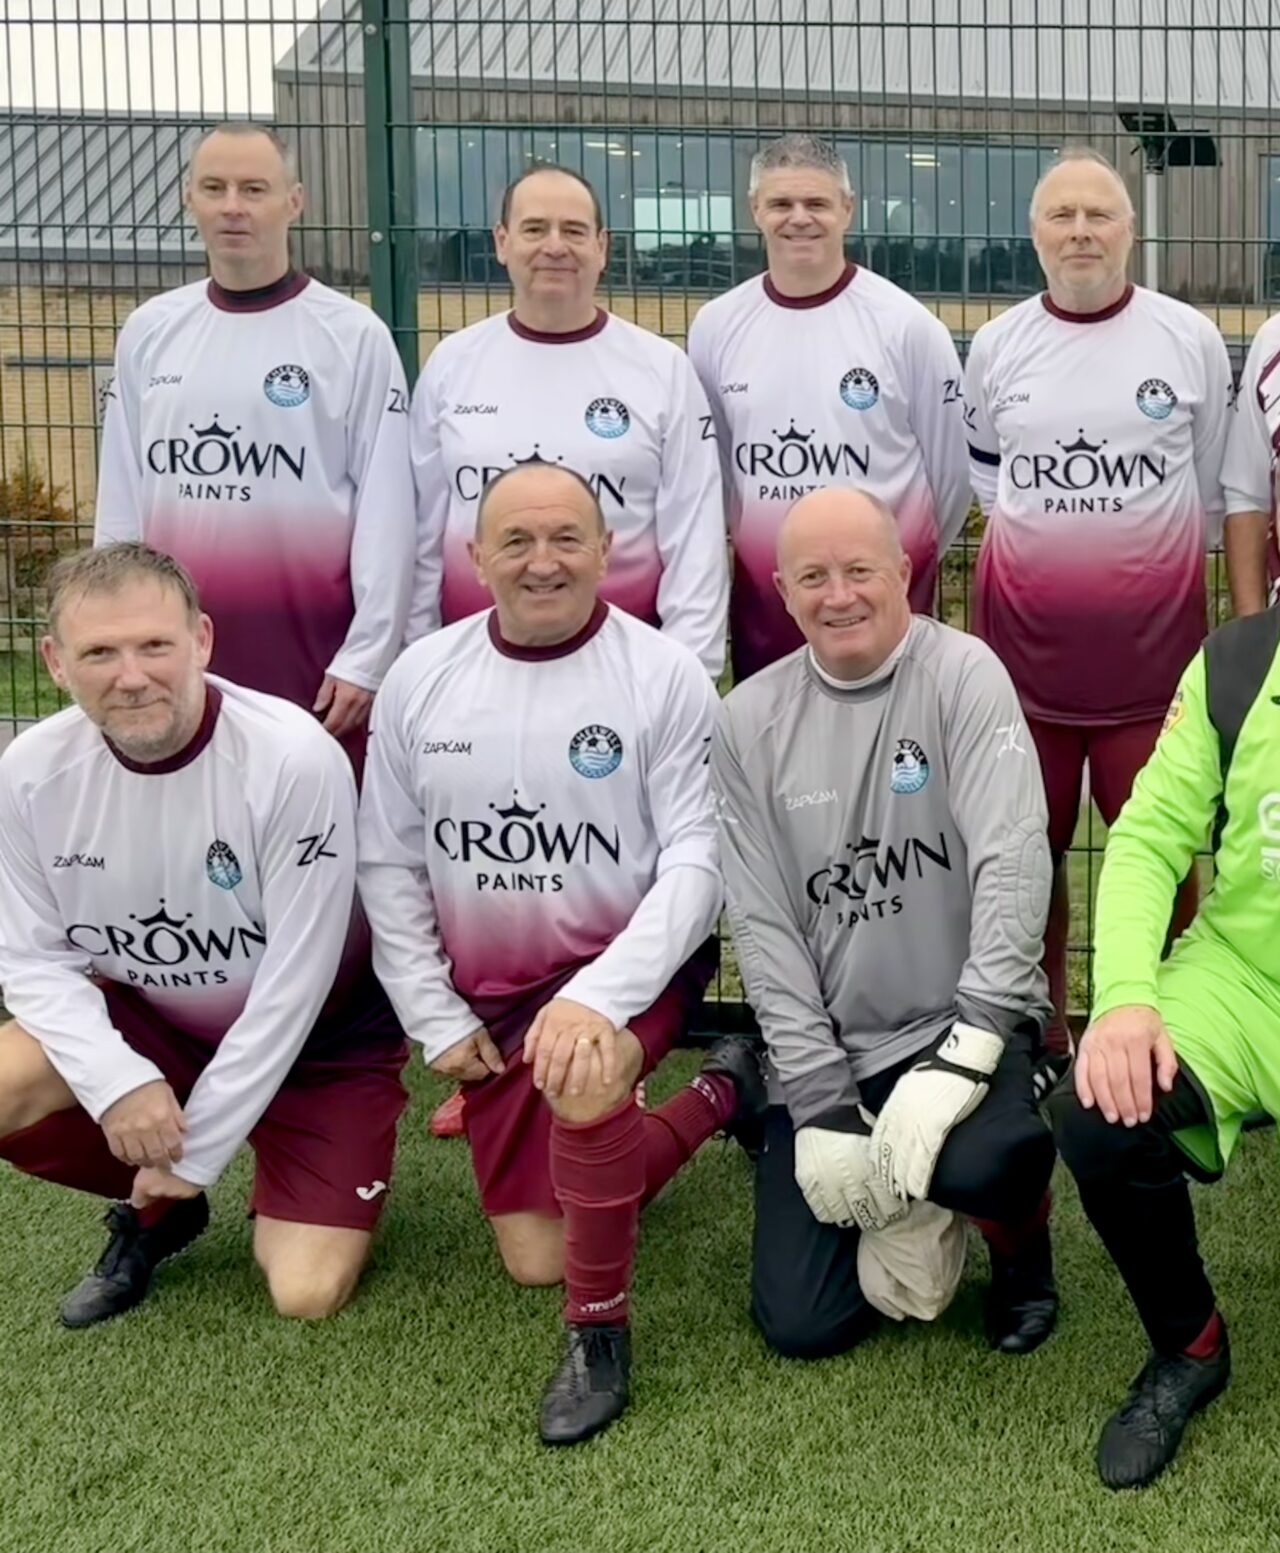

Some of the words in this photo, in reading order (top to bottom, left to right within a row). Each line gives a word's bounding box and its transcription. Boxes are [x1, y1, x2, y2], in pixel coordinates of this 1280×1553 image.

[147, 438, 305, 482] CROWN
[736, 443, 870, 477] CROWN
[1010, 454, 1166, 490] CROWN
[759, 484, 827, 500] PAINT
[1044, 497, 1123, 513] PAINTS
[423, 740, 472, 755] ZAPKAM
[785, 790, 839, 811] ZAPKAM
[297, 823, 338, 866] ZK
[434, 818, 620, 866] CROWN
[53, 855, 105, 870] ZAPKAM
[477, 872, 563, 893] PAINTS
[66, 920, 266, 965] CROWN
[127, 969, 228, 987] PAINTS
